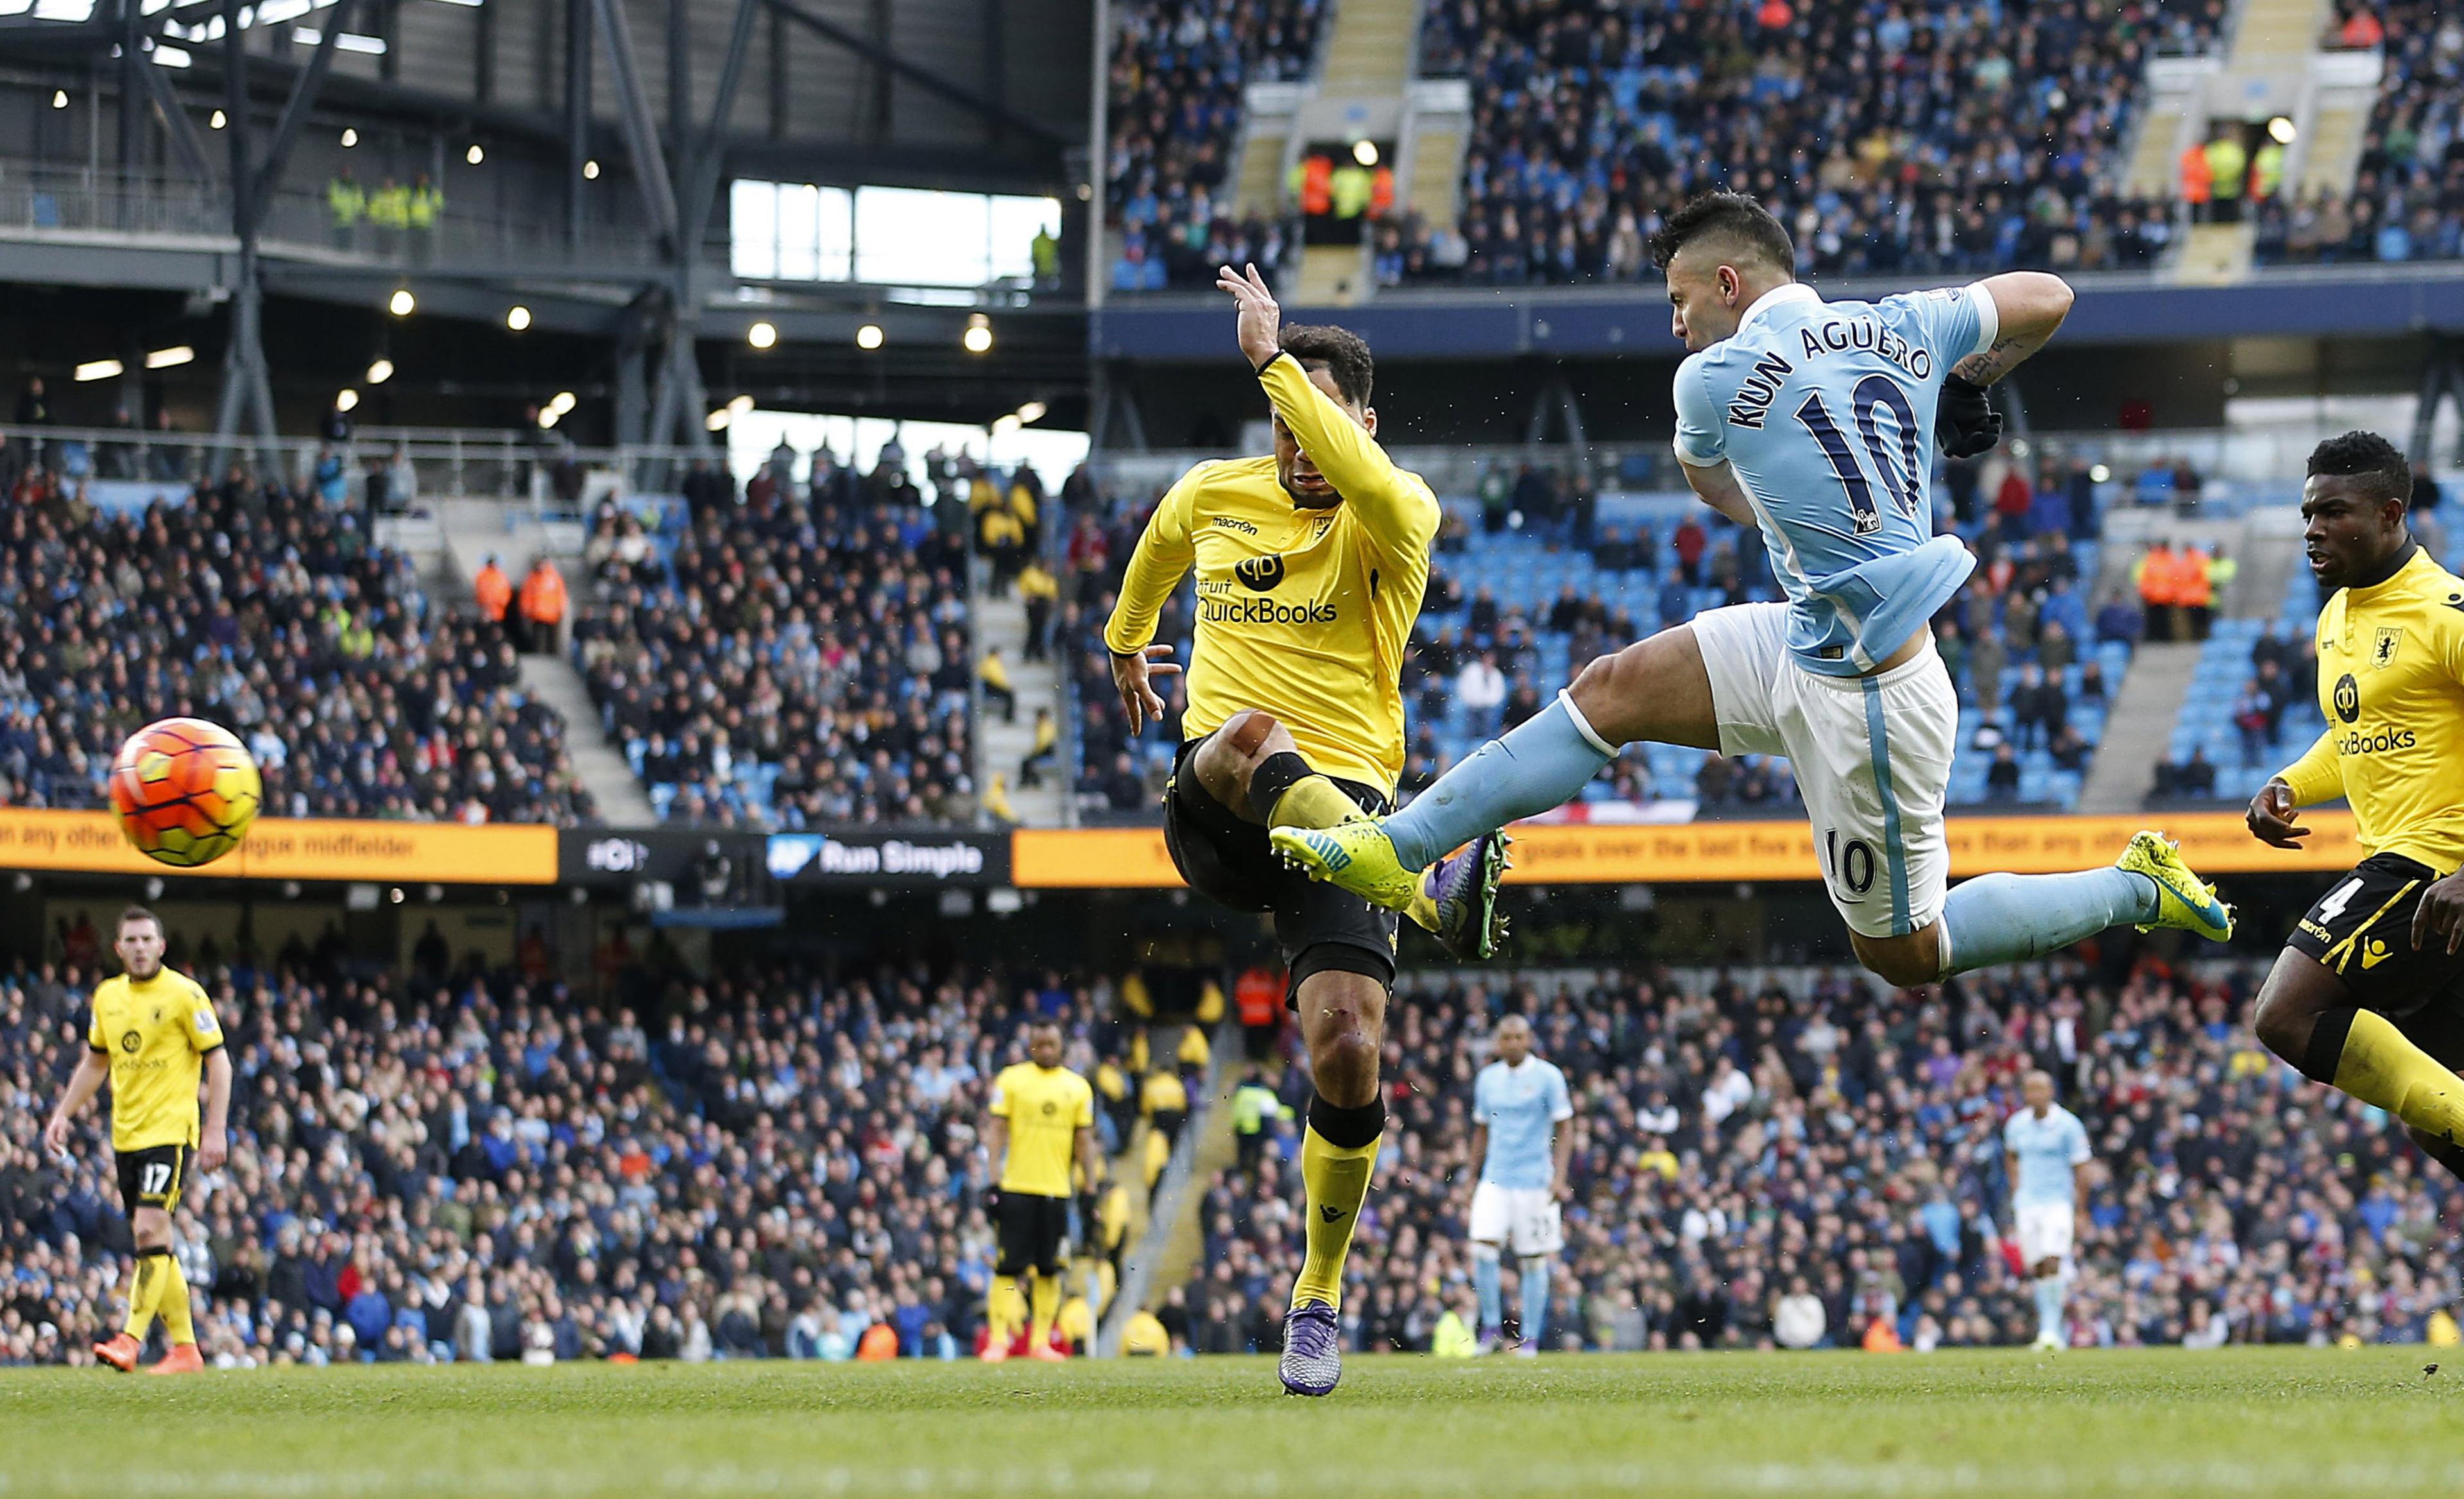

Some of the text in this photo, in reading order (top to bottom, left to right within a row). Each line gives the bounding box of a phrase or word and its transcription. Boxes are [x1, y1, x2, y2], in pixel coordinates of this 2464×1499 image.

[1727, 351, 1794, 430] KUN
[1793, 373, 1919, 535] 10
[1212, 517, 1258, 536] macron
[819, 839, 879, 873] Run
[881, 839, 984, 879] Simple
[1825, 828, 1877, 896] 10
[2318, 877, 2365, 924] 4
[144, 1163, 172, 1194] 17
